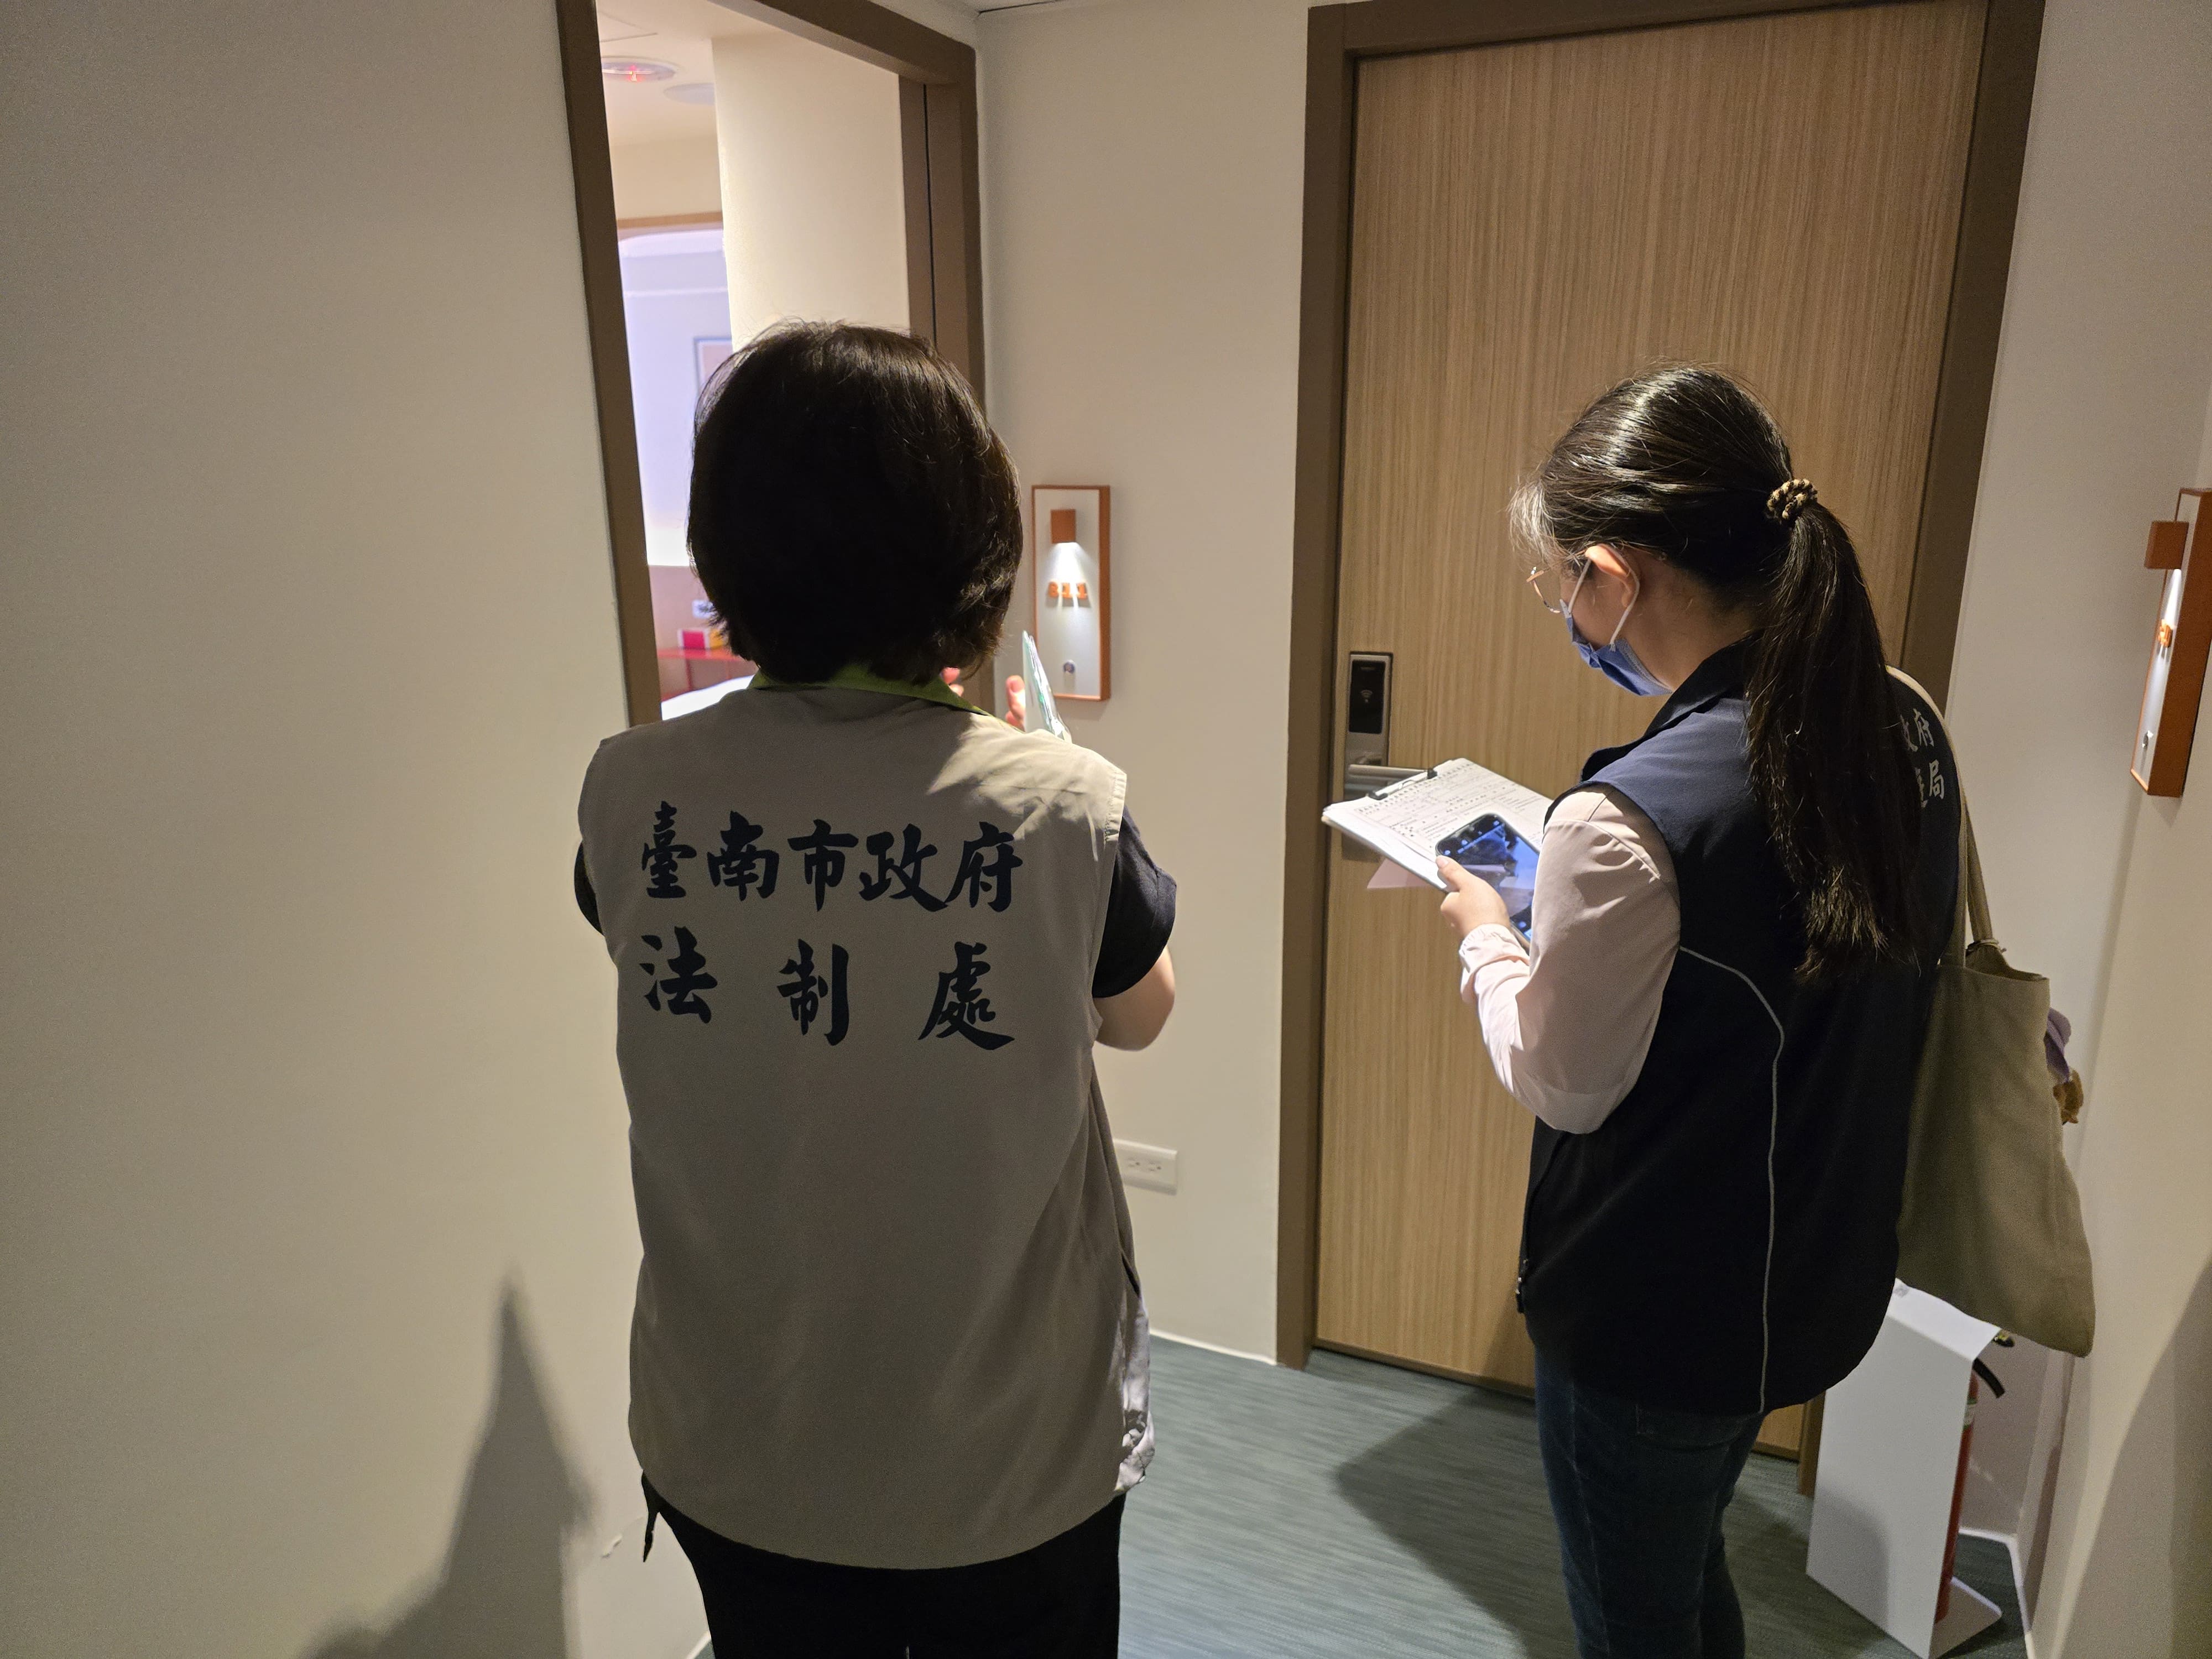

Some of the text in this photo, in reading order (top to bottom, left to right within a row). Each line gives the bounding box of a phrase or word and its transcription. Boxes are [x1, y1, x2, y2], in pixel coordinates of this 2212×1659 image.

[641, 800, 1023, 912] 臺南市政府
[639, 926, 1016, 1051] 法制處
